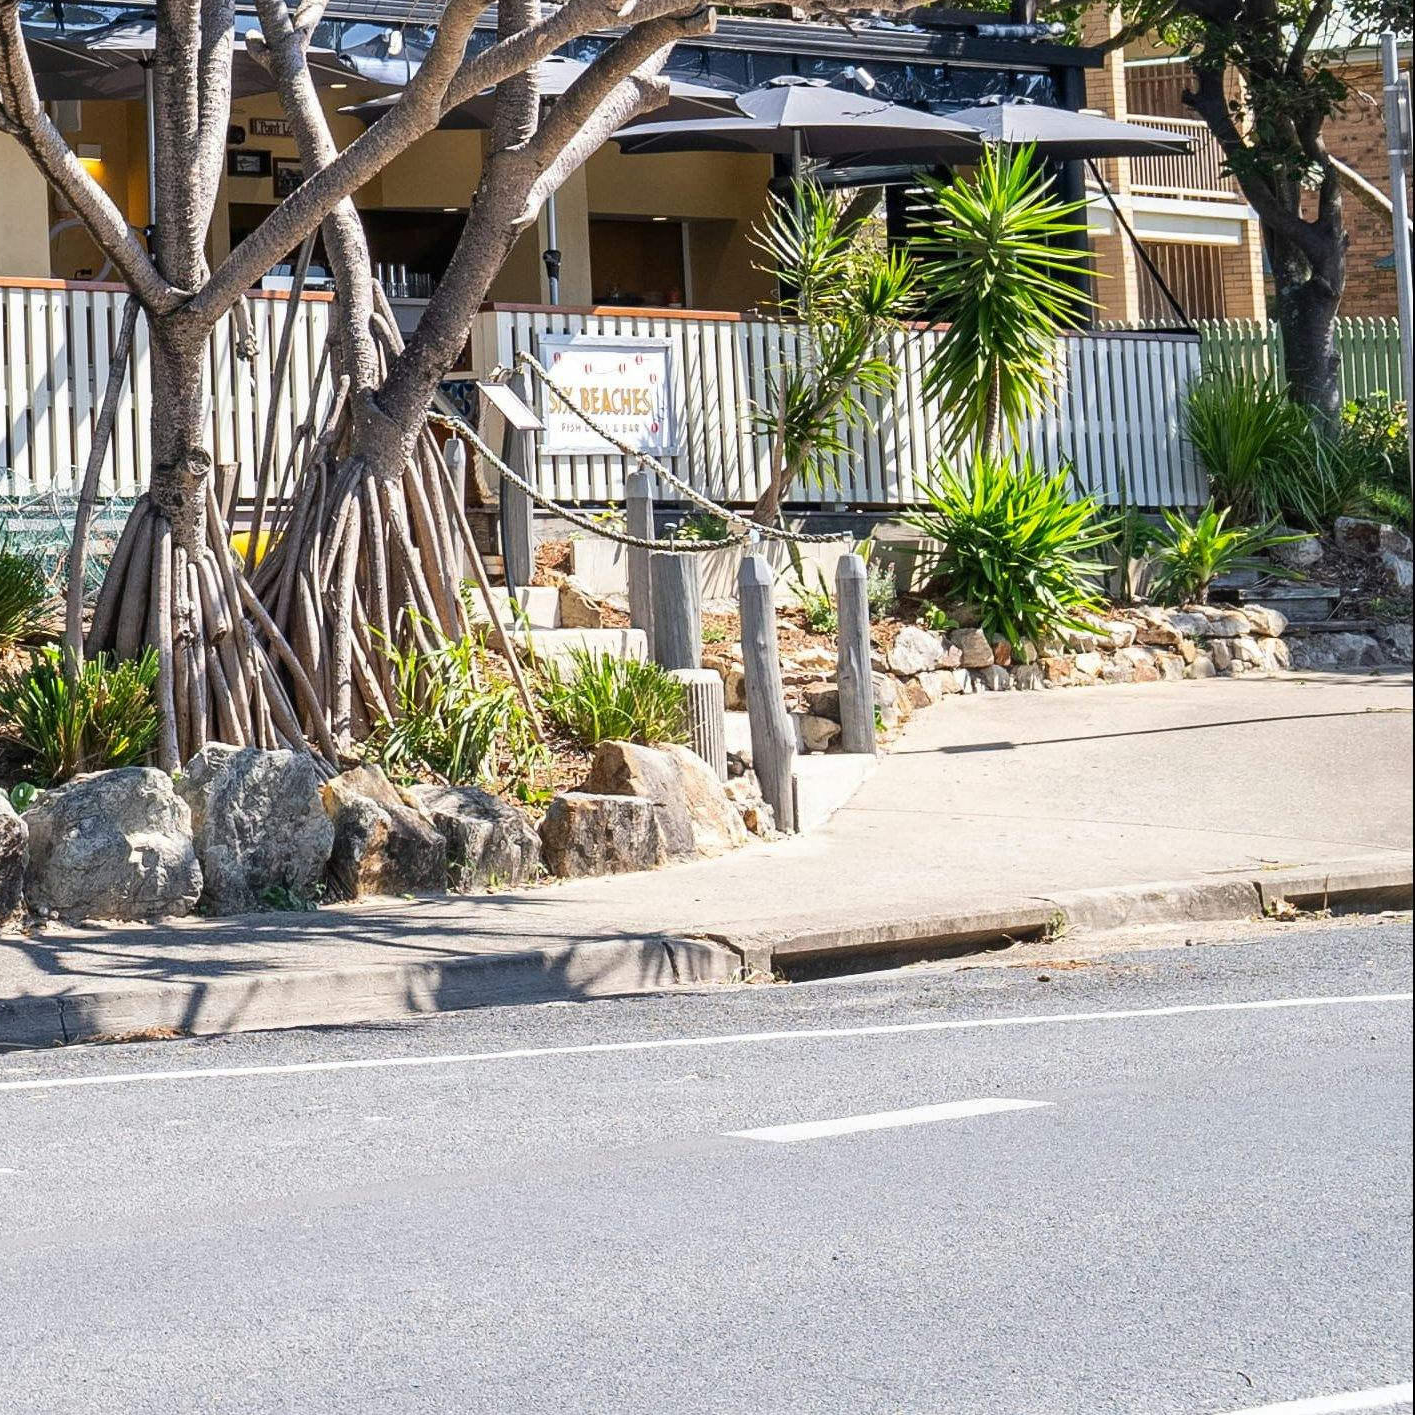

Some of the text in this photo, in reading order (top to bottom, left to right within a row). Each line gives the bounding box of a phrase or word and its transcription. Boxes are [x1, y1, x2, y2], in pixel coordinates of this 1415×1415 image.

[580, 387, 652, 415] BEACHES
[561, 423, 581, 433] FISH
[622, 425, 640, 433] BAR
